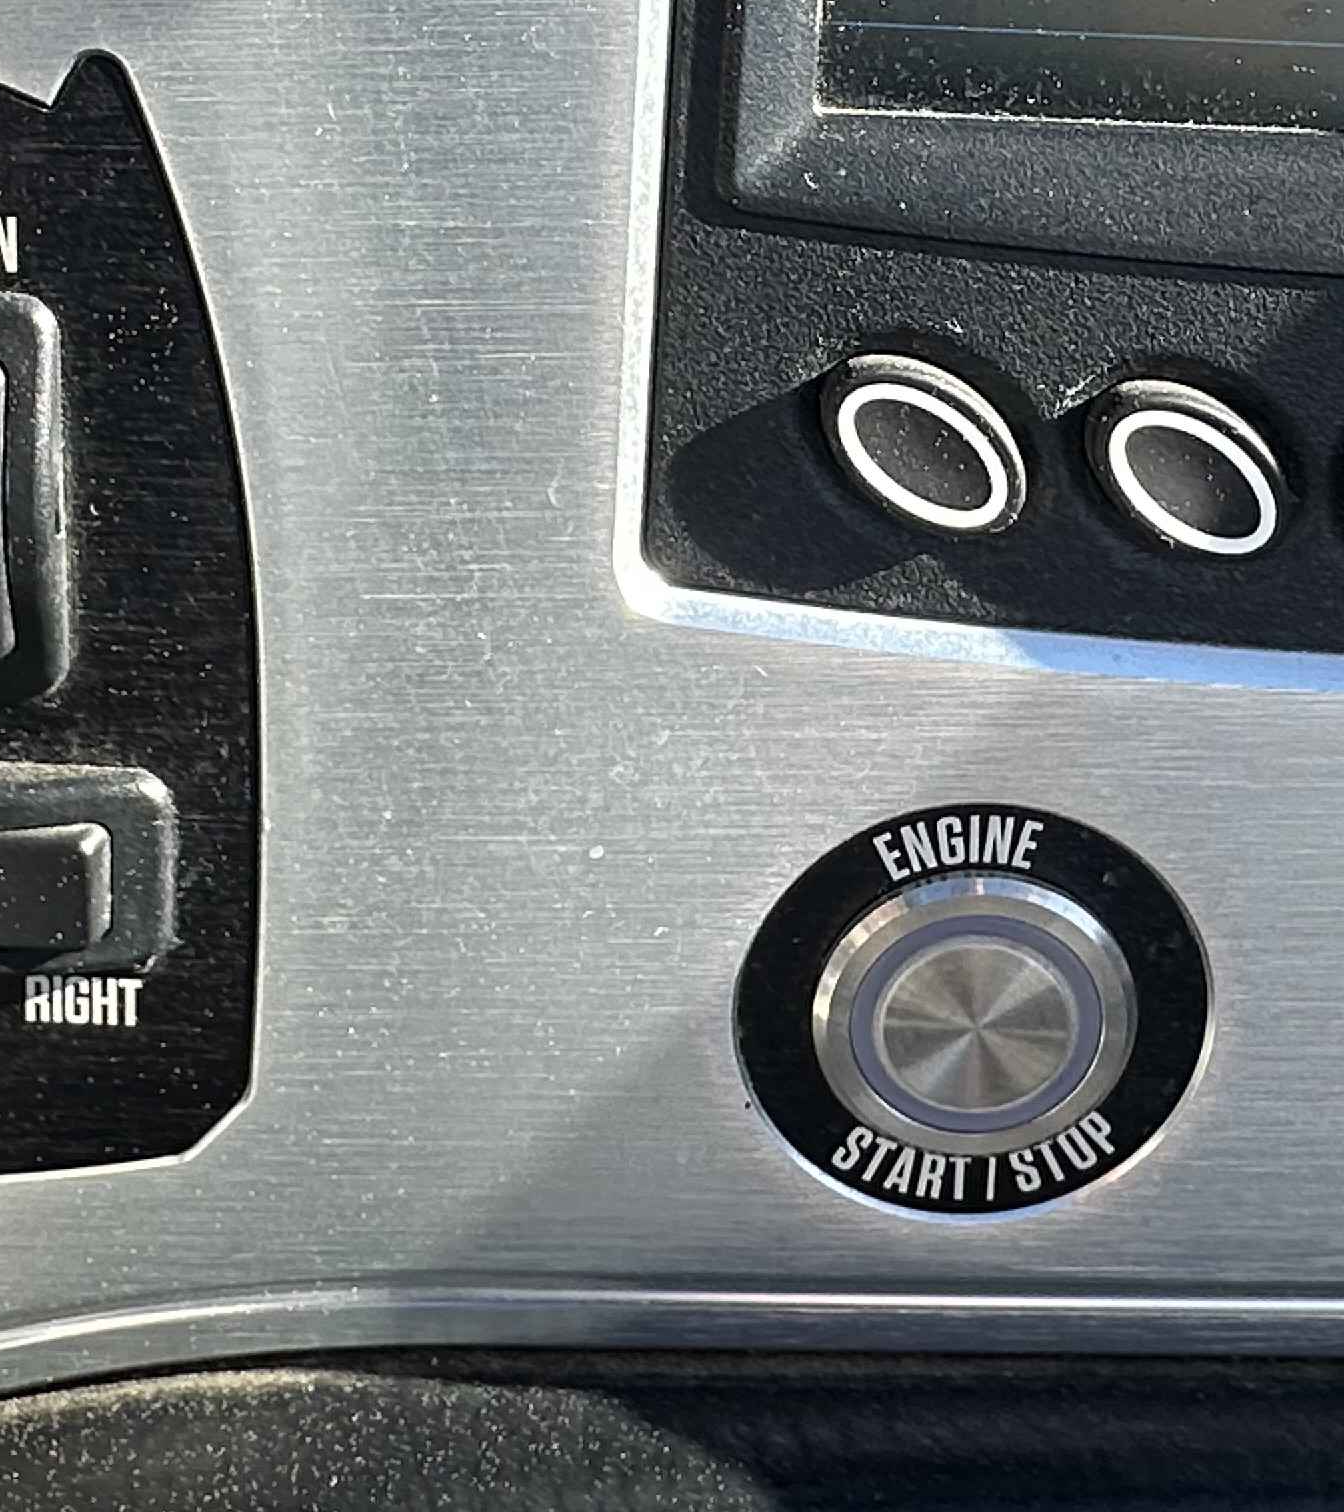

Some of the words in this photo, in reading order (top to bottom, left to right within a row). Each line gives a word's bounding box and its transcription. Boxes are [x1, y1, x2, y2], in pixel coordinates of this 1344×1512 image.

[872, 813, 1045, 882] ENGINE
[23, 971, 143, 1028] RIGHT
[830, 1125, 972, 1200] START
[1008, 1110, 1115, 1193] STOP
